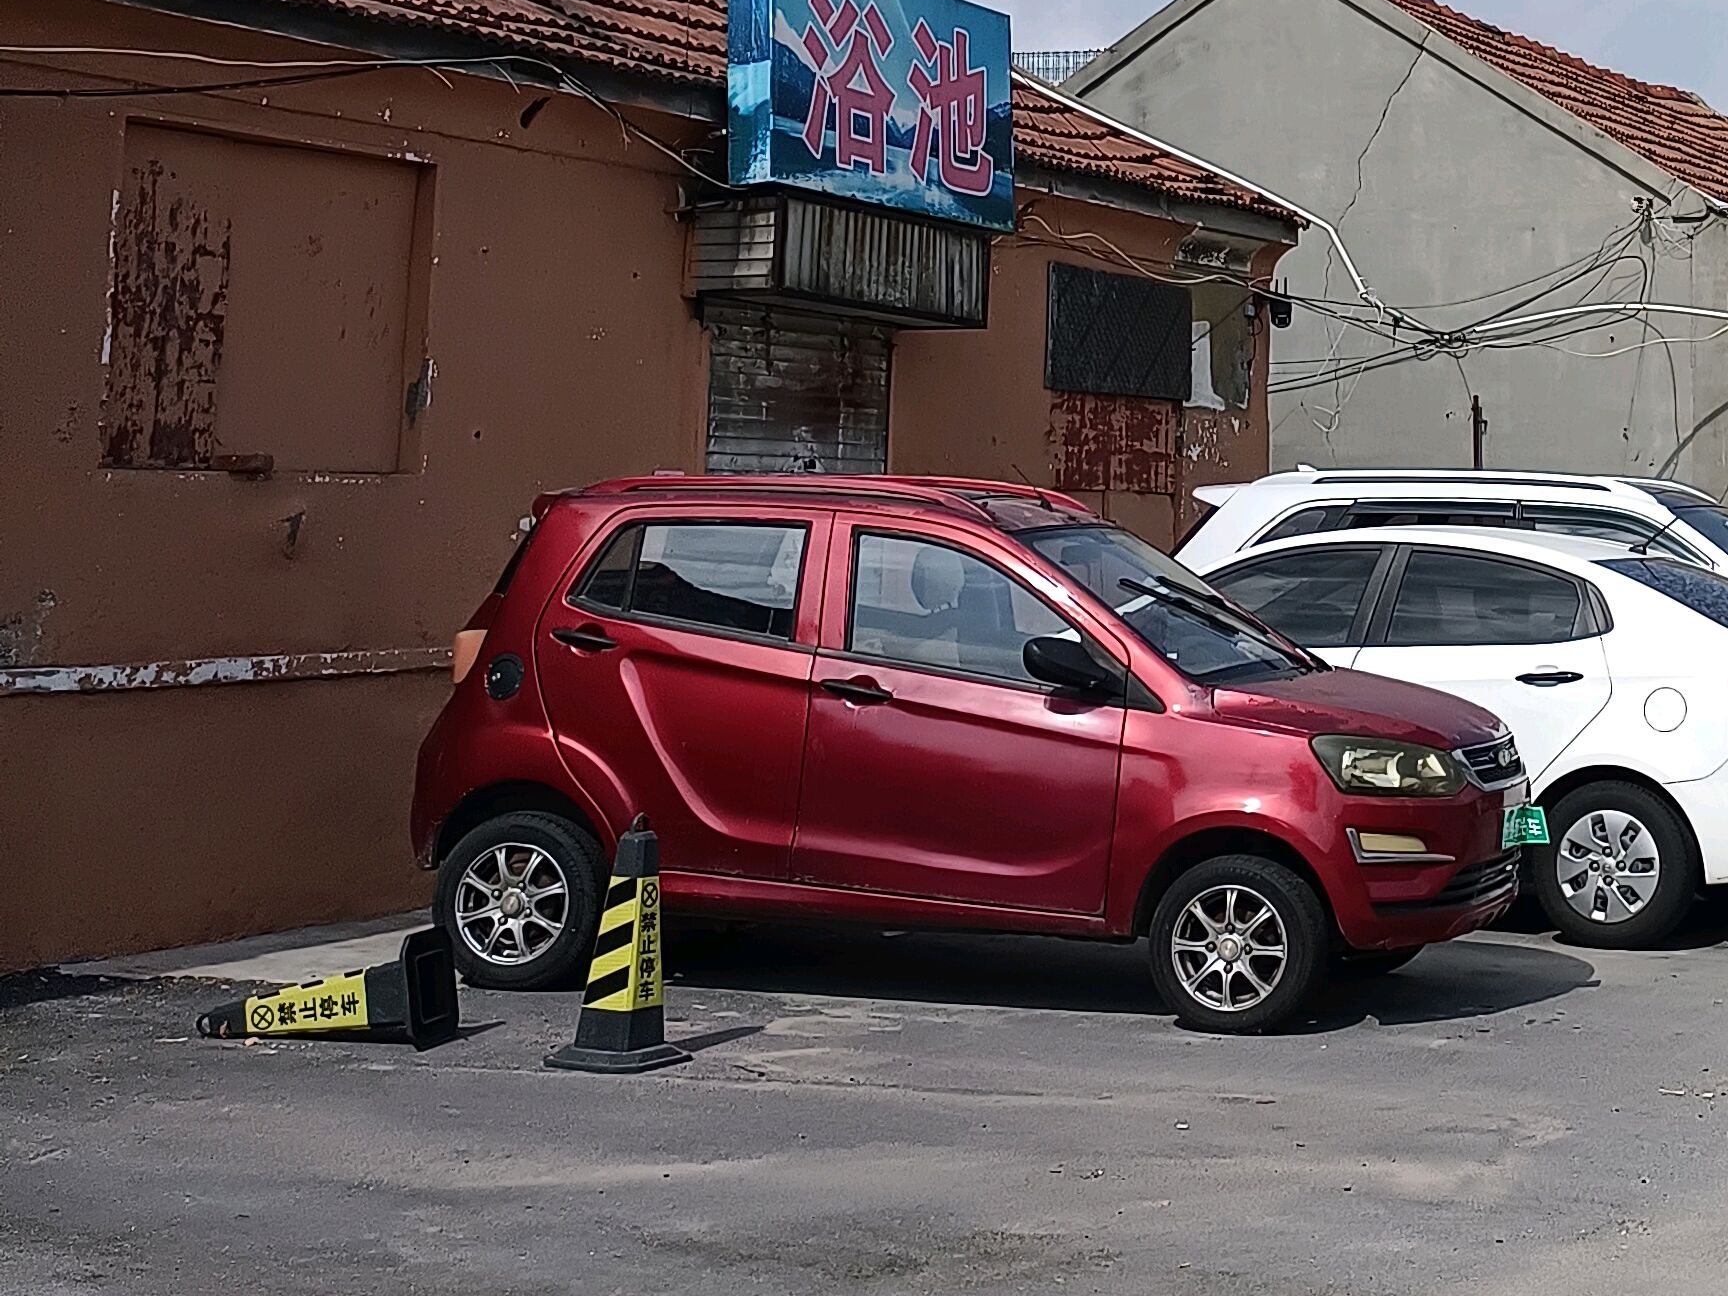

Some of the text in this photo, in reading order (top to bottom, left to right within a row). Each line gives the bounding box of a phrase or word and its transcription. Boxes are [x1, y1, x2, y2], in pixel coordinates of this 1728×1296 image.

[638, 912, 657, 1002] 禁止停车
[277, 992, 360, 1026] 禁止停车
